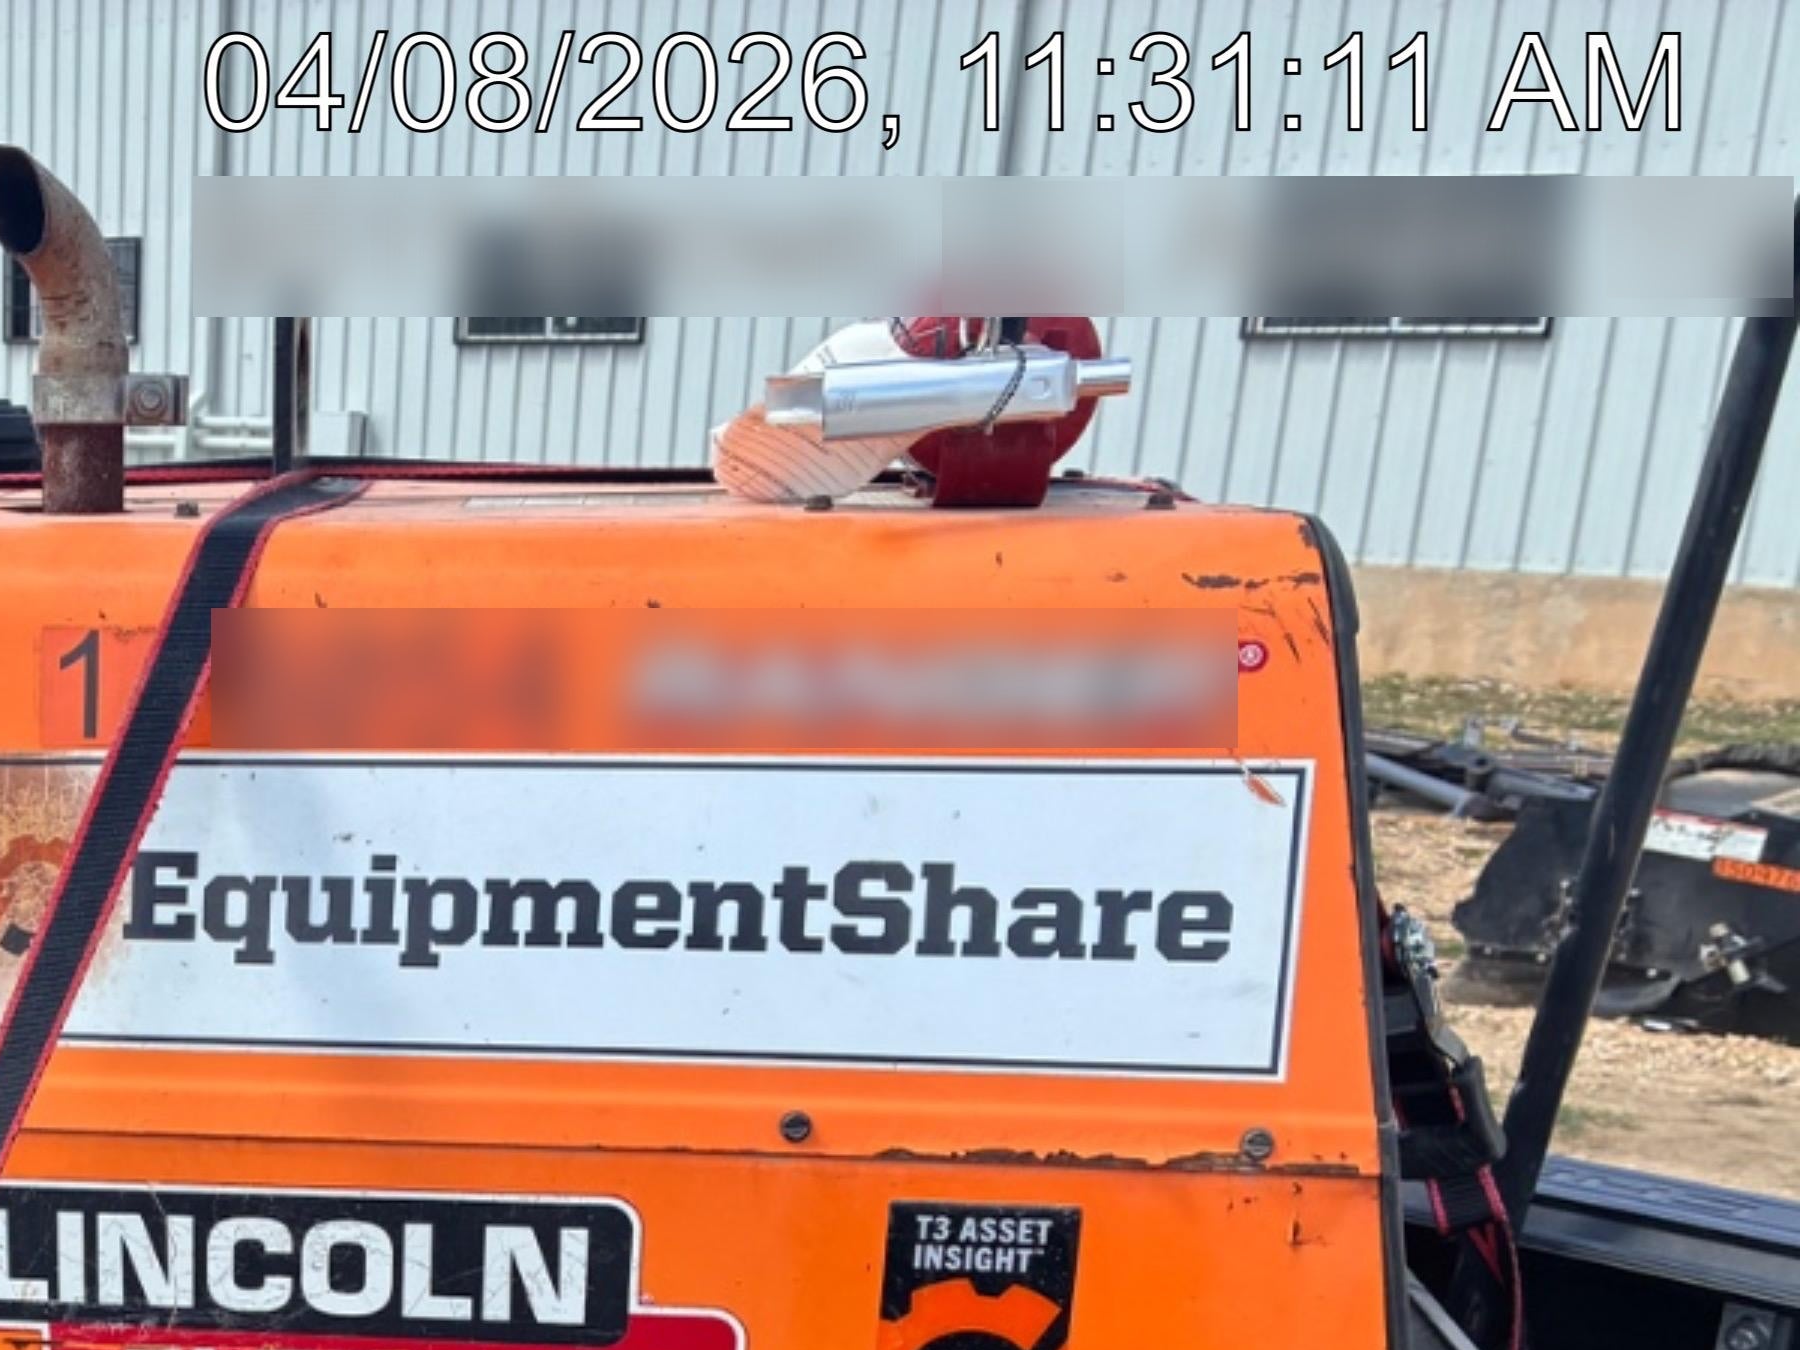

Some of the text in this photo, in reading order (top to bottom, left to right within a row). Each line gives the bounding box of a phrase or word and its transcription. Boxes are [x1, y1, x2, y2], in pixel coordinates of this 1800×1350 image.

[123, 851, 1234, 969] EquipmentShare
[915, 1214, 1054, 1246] T3 ASSET
[912, 1244, 1035, 1273] INSIGHT
